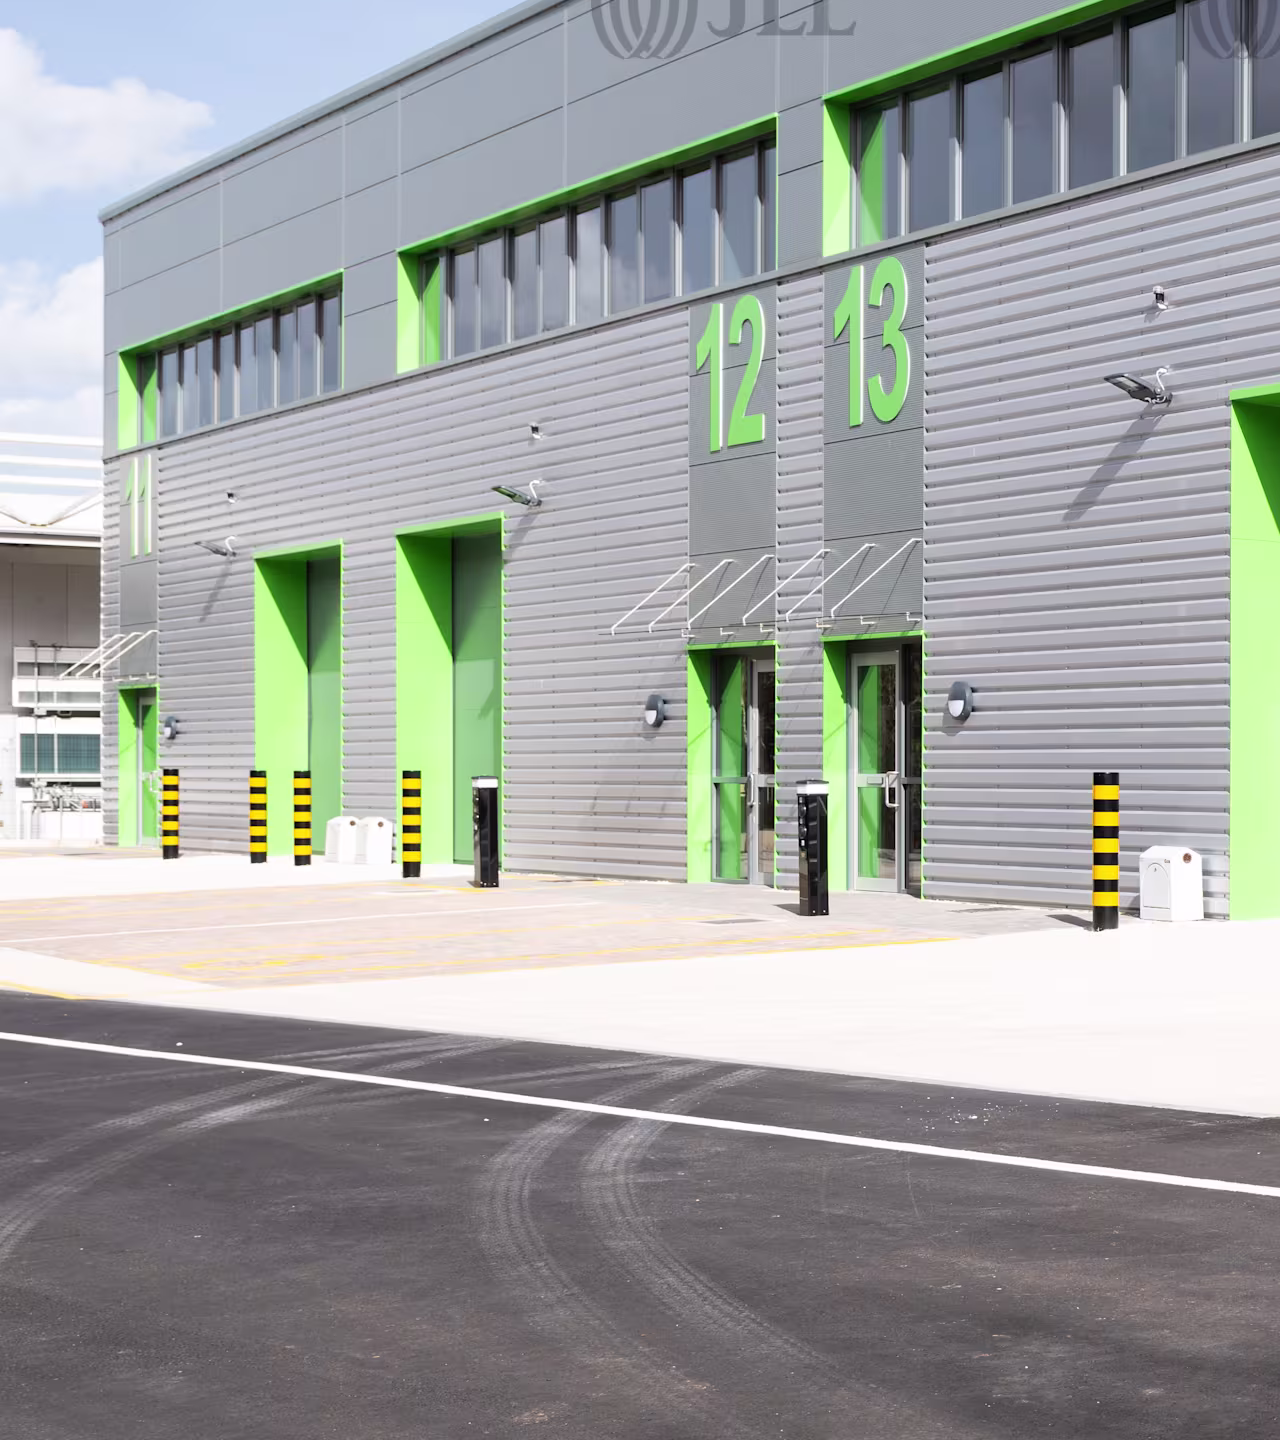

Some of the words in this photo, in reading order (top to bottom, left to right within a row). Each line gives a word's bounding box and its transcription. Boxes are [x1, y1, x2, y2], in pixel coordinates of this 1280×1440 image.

[695, 294, 766, 454] 12
[833, 255, 911, 429] 13
[125, 453, 152, 559] 11
